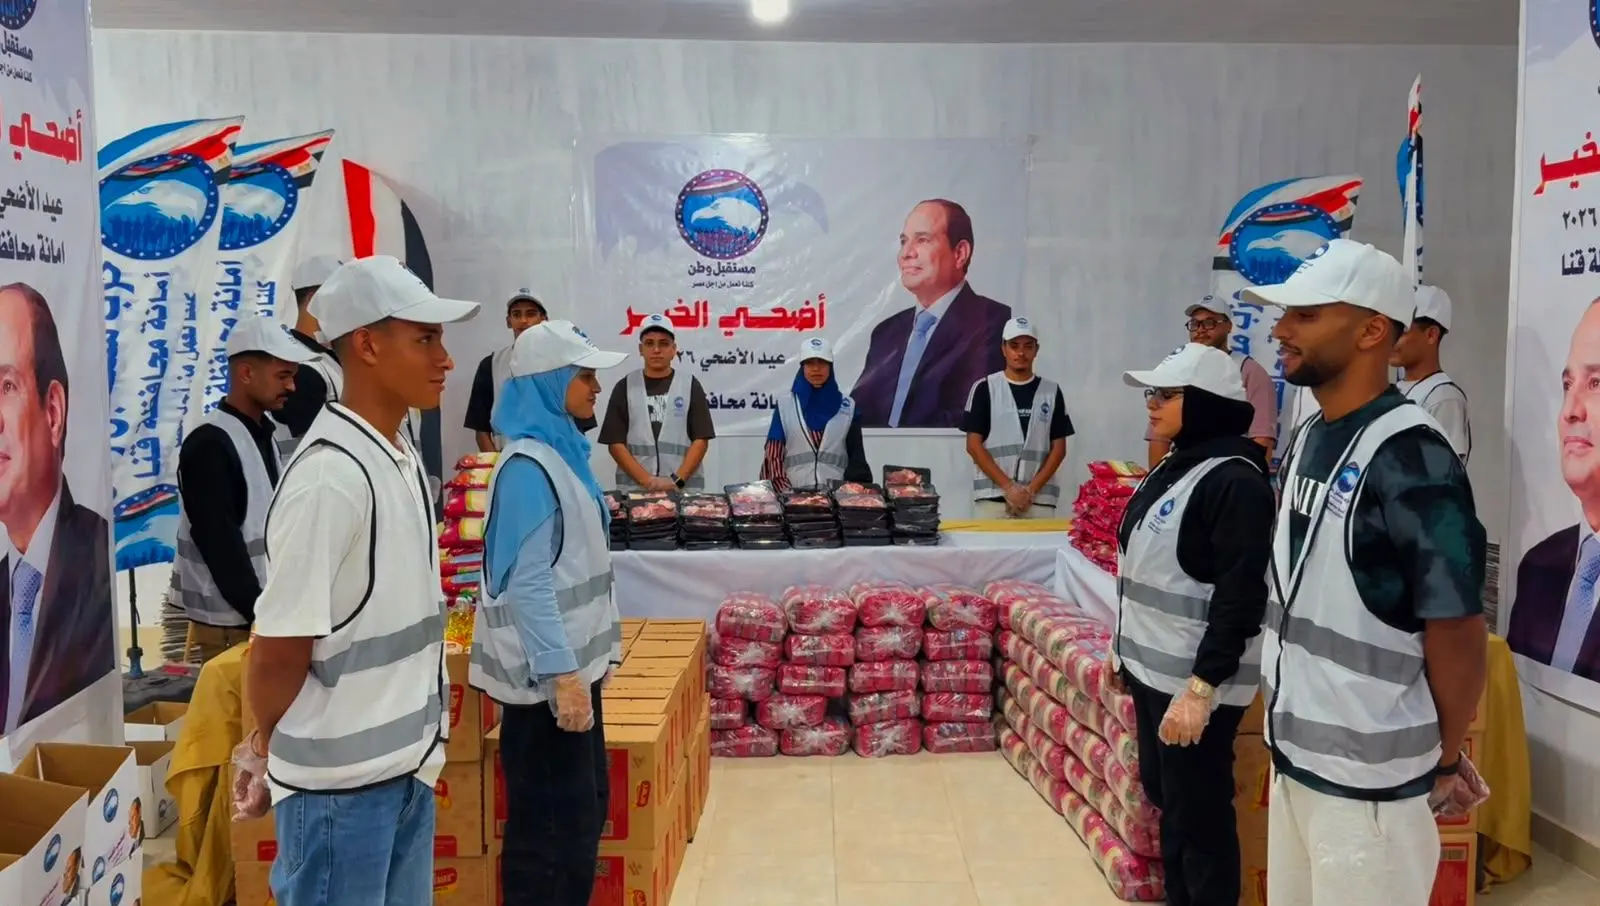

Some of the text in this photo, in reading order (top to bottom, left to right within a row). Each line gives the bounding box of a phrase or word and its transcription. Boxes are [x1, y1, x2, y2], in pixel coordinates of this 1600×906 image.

[0, 30, 33, 61] مستقبل
[9, 108, 82, 164] أضحي
[1533, 131, 1600, 195] خير
[43, 192, 63, 223] عيد
[1562, 208, 1598, 230] ٢٠٢٦
[0, 230, 36, 261] محافظ
[687, 261, 756, 277] مستقبل وطن
[1561, 249, 1585, 276] قنا
[718, 292, 826, 337] أضحي
[676, 346, 786, 372] عيد الأضحي ٢٦
[707, 392, 778, 410] انة محاف
[129, 436, 161, 478] قنا
